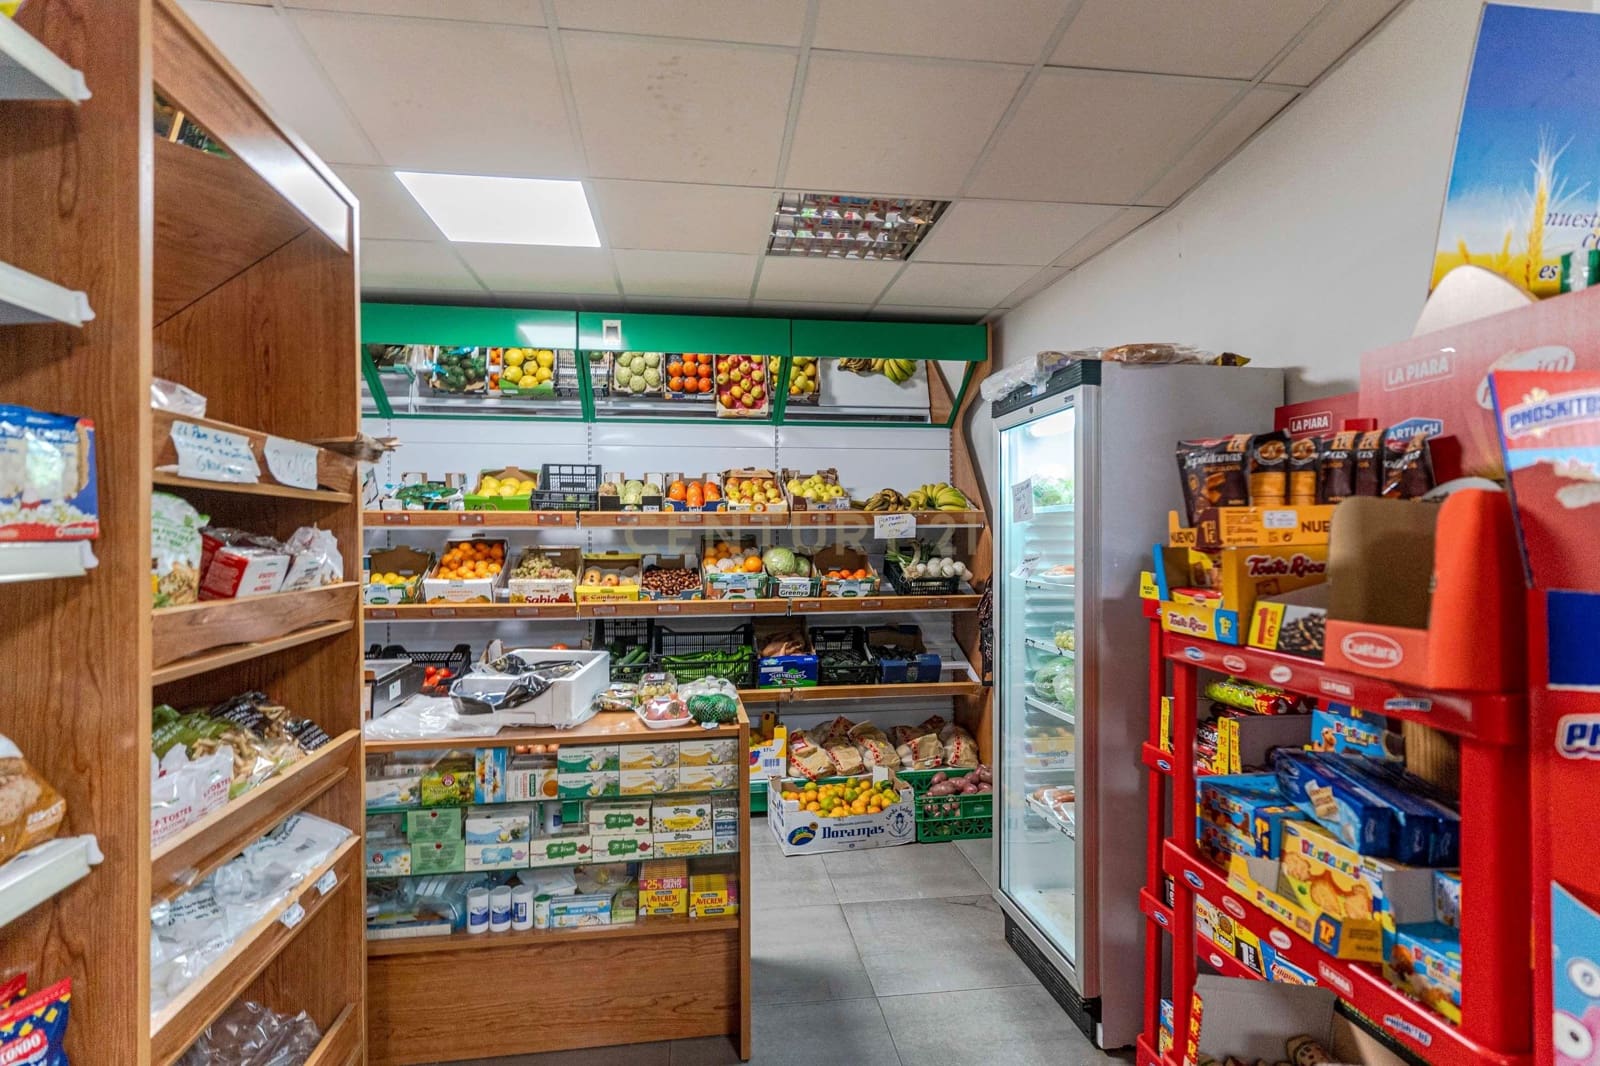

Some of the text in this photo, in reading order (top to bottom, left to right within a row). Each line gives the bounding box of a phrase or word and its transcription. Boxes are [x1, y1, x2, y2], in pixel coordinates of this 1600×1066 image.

[1545, 211, 1600, 229] nuest
[1538, 264, 1559, 280] es
[1387, 357, 1449, 386] LA PIARA
[1292, 416, 1329, 432] LA PIARA
[1387, 423, 1439, 440] ARTIACH
[1301, 520, 1331, 533] NUE
[1247, 555, 1289, 577] Tosta
[650, 894, 678, 904] AVECREM
[695, 896, 723, 906] AVECREM
